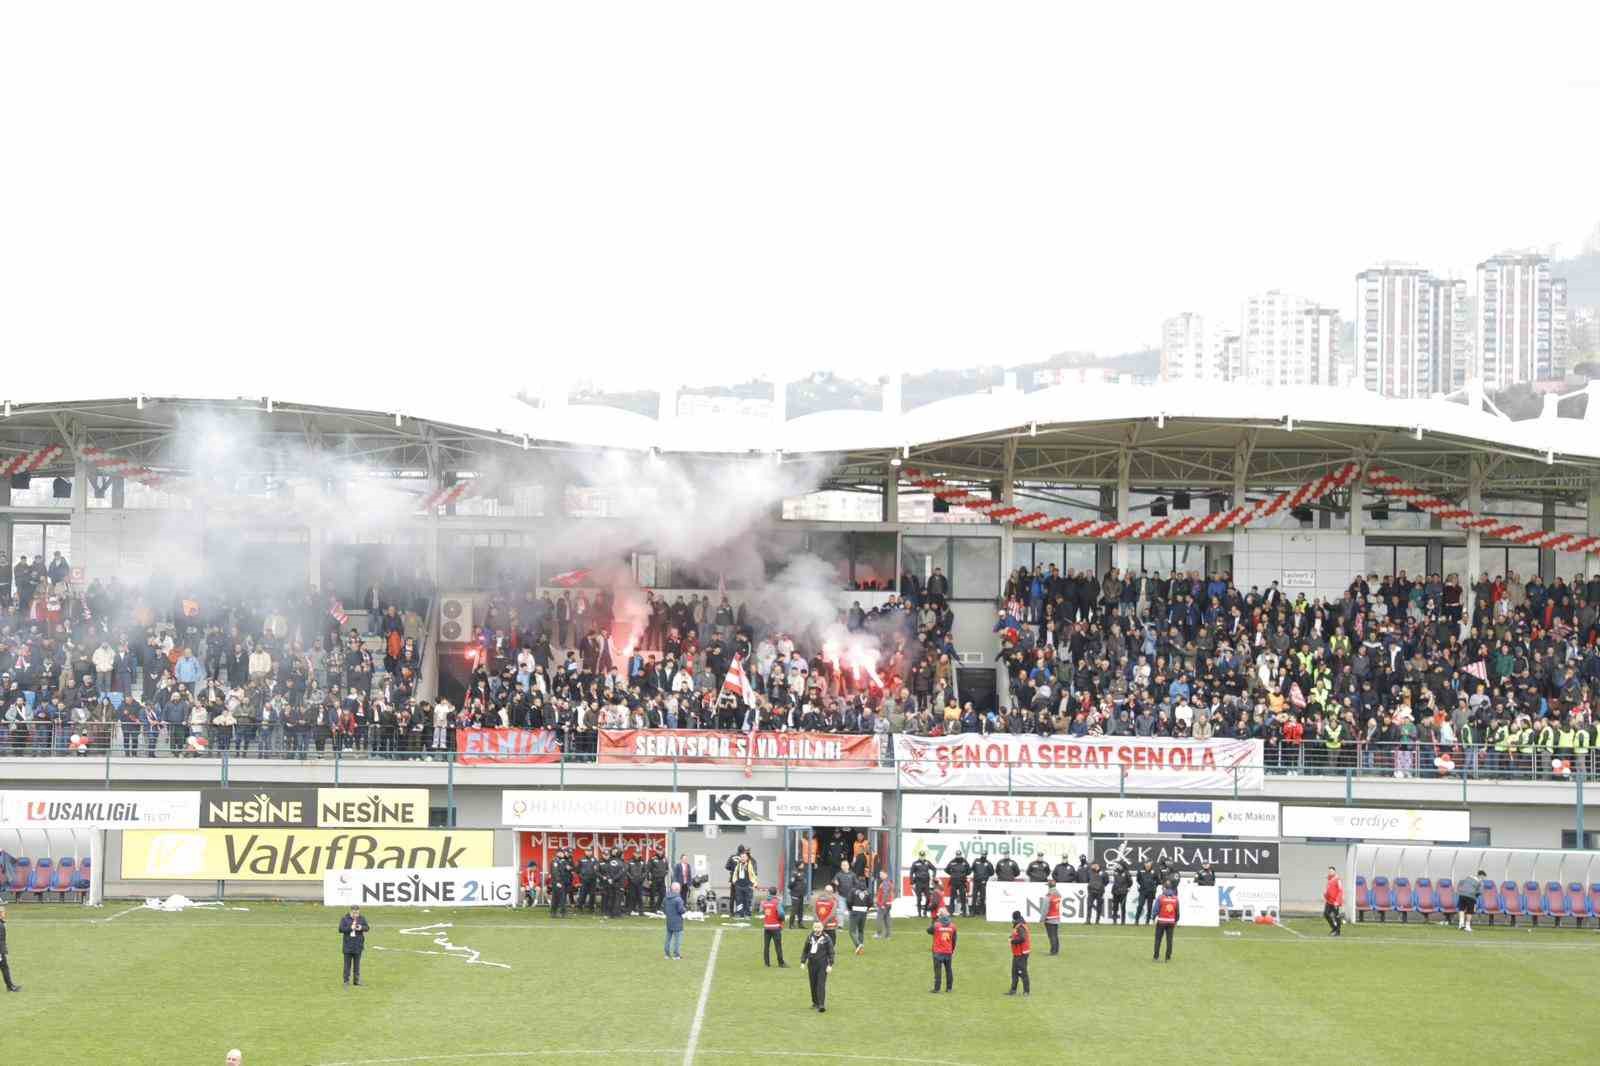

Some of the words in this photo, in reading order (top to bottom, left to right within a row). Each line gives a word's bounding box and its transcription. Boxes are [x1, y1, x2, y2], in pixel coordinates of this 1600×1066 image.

[986, 744, 1032, 768] OLA
[1038, 744, 1113, 769] SEBAT
[1169, 748, 1217, 771] OLA
[708, 794, 776, 822] KCT
[968, 800, 1083, 817] ARHAL
[1159, 812, 1210, 823] KOMATSU
[225, 834, 467, 874] VakıfBank
[960, 837, 1035, 859] yöneliş
[462, 880, 478, 901] 2
